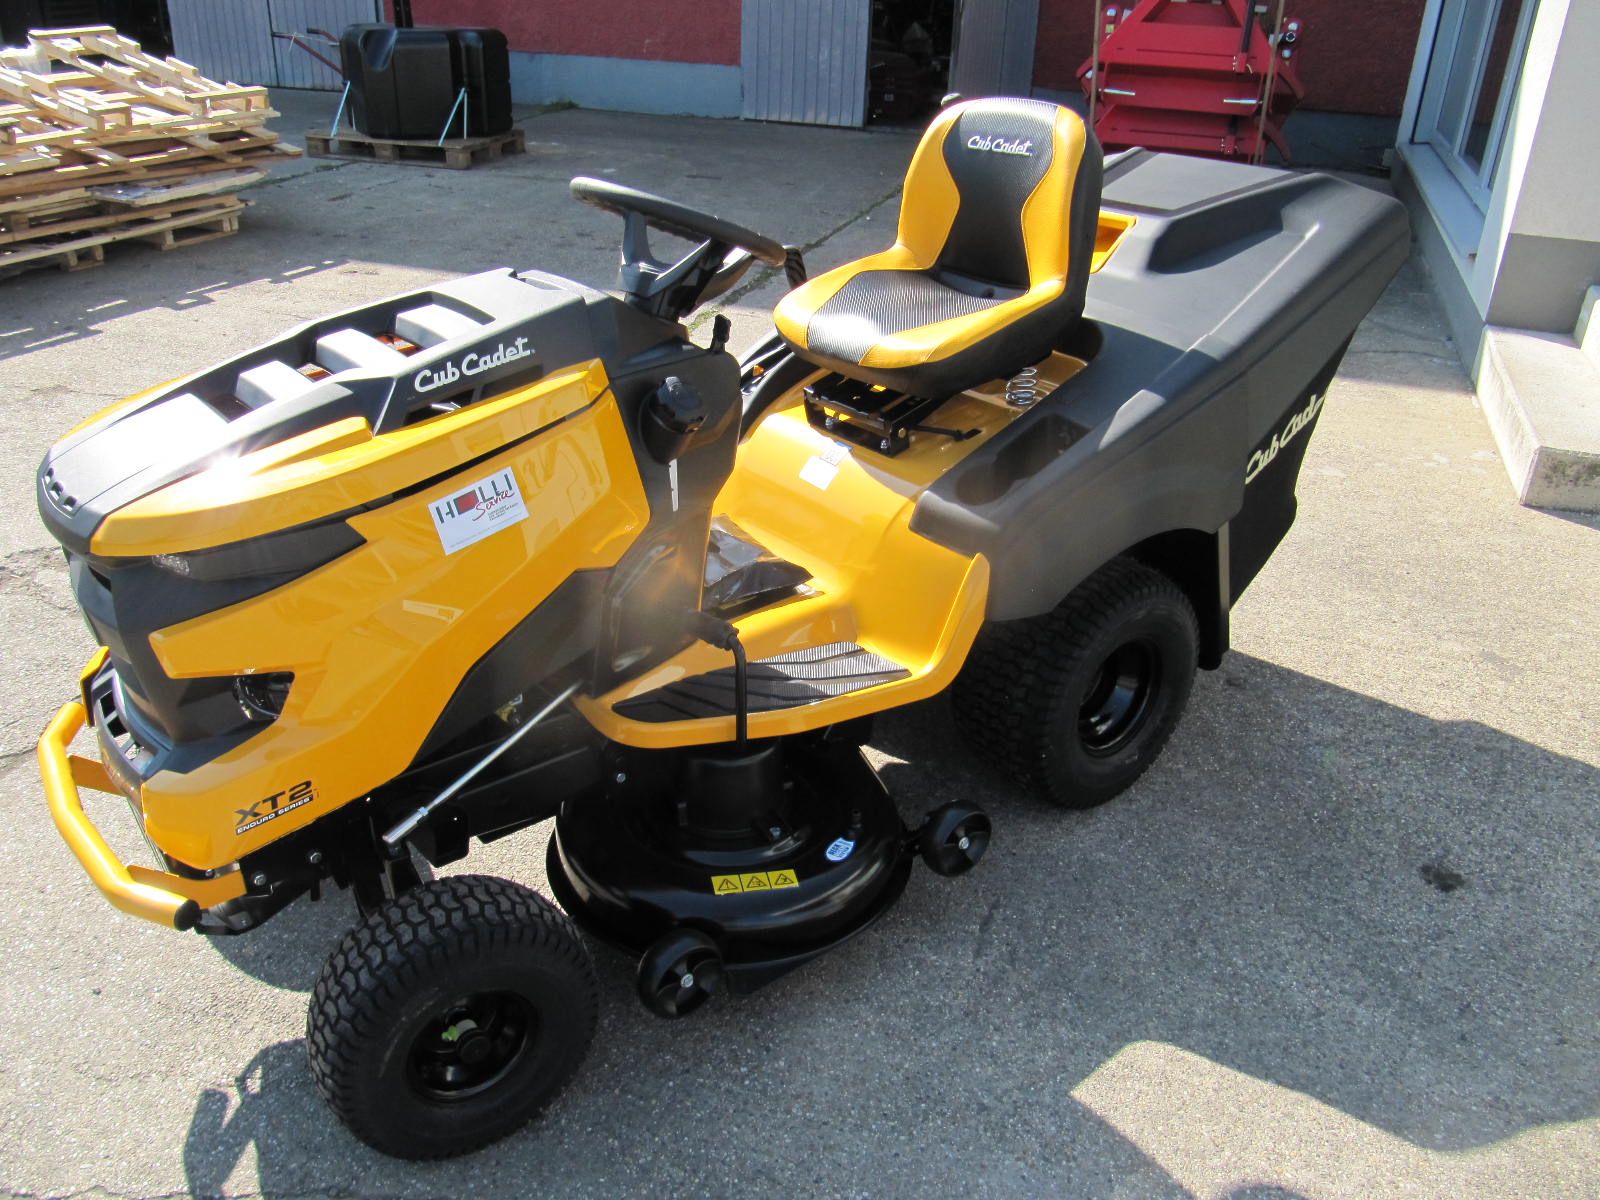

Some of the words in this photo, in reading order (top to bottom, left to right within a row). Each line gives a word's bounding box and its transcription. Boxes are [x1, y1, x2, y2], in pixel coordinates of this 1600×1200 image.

[968, 135, 991, 151] Cub
[992, 138, 1033, 157] Cadet
[414, 361, 460, 393] Cub
[461, 336, 531, 376] Cadet
[1244, 433, 1280, 485] Cub
[234, 780, 312, 826] XT2
[236, 812, 276, 834] ENDURO
[278, 795, 311, 815] SERIES
